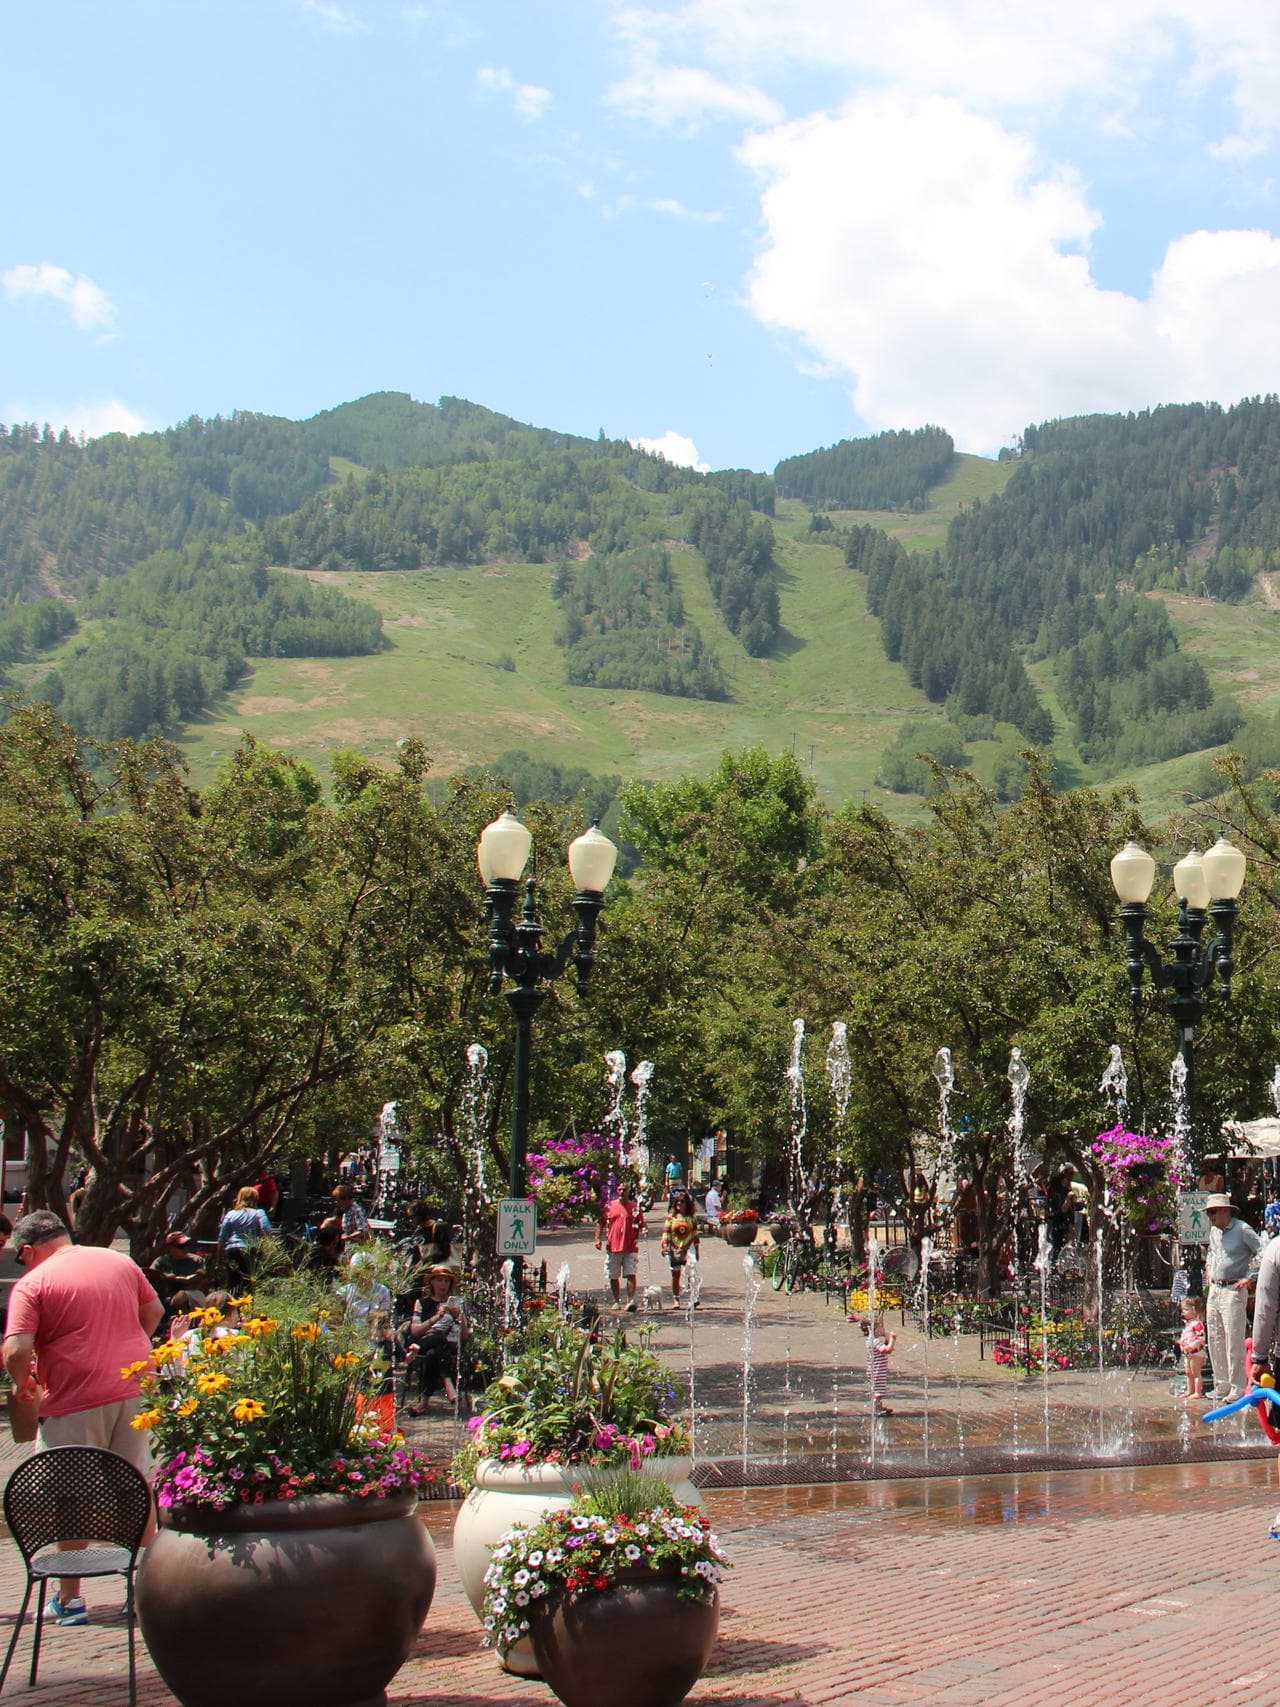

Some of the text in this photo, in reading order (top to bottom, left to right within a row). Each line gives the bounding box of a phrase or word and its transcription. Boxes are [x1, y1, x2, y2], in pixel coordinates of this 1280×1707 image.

[503, 1205, 531, 1213] WALK
[1184, 1231, 1206, 1239] ONLY
[503, 1241, 529, 1250] ONLY
